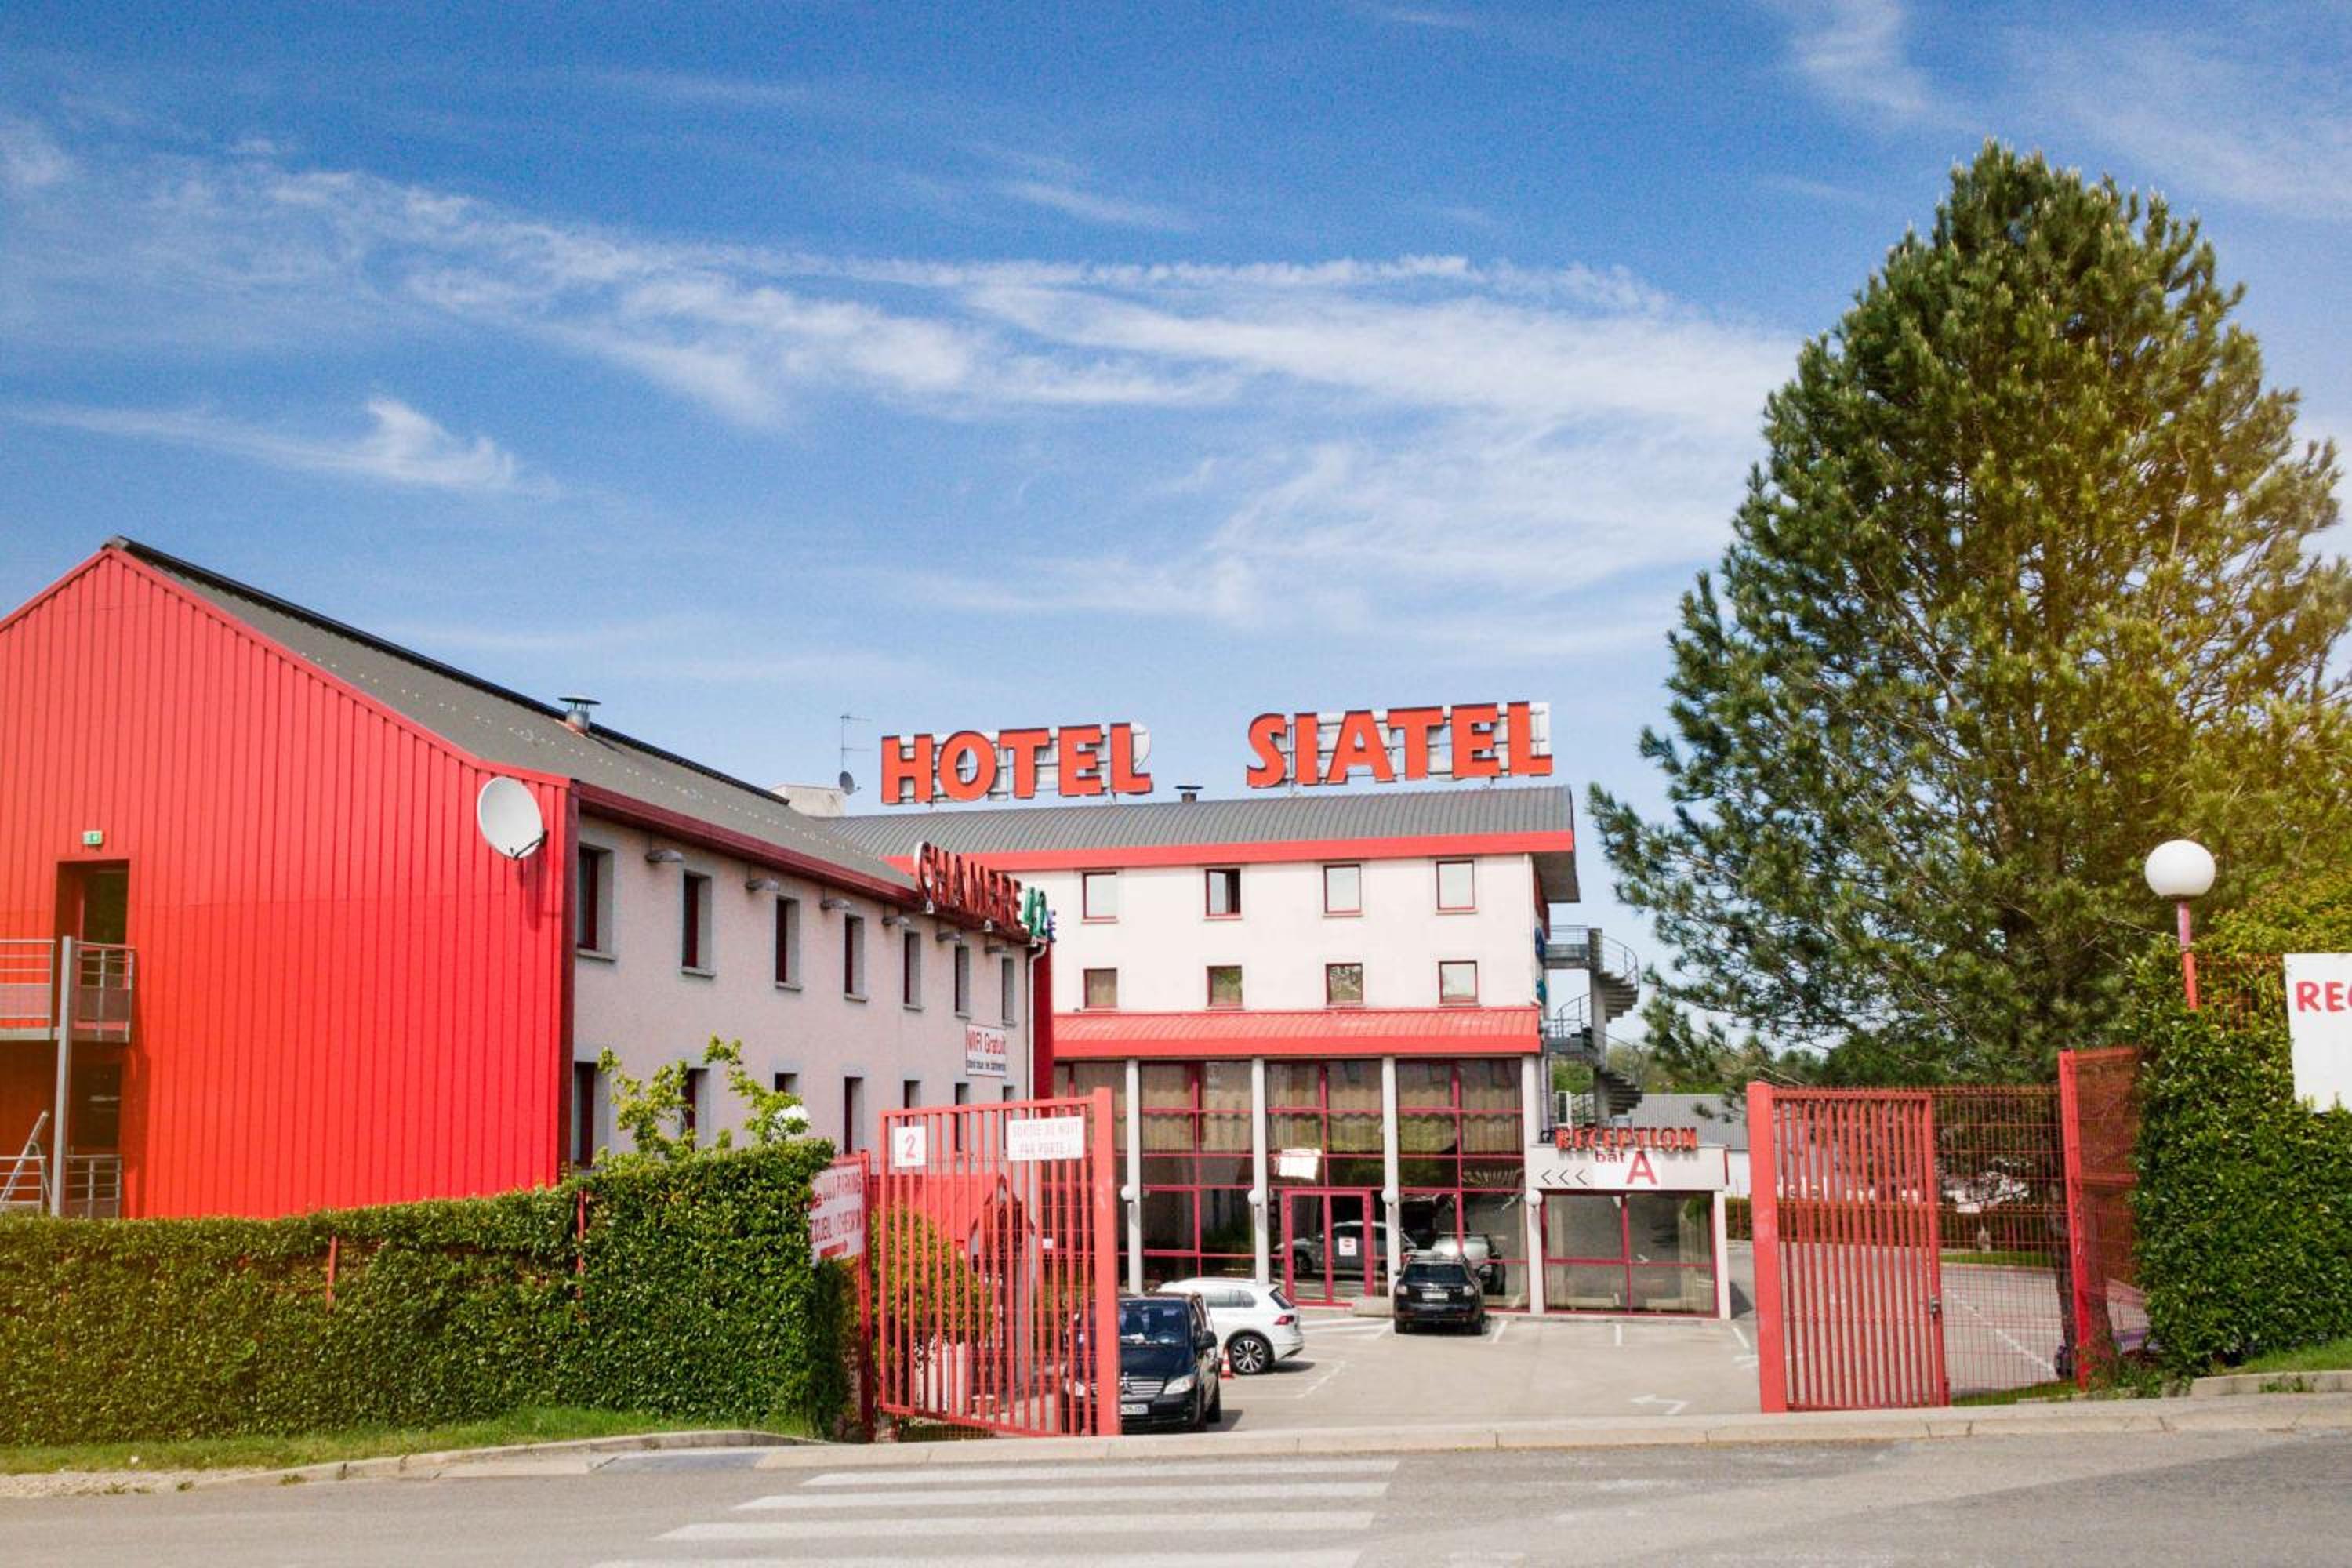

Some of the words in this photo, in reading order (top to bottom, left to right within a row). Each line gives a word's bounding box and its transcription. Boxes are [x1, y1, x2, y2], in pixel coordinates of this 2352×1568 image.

[881, 723, 1152, 804] HOTEL
[1247, 701, 1552, 789] SIATEL
[2296, 981, 2352, 1013] RE
[905, 1134, 916, 1159] 2
[1555, 1127, 1697, 1152] RECEPTION
[1626, 1150, 1657, 1185] A
